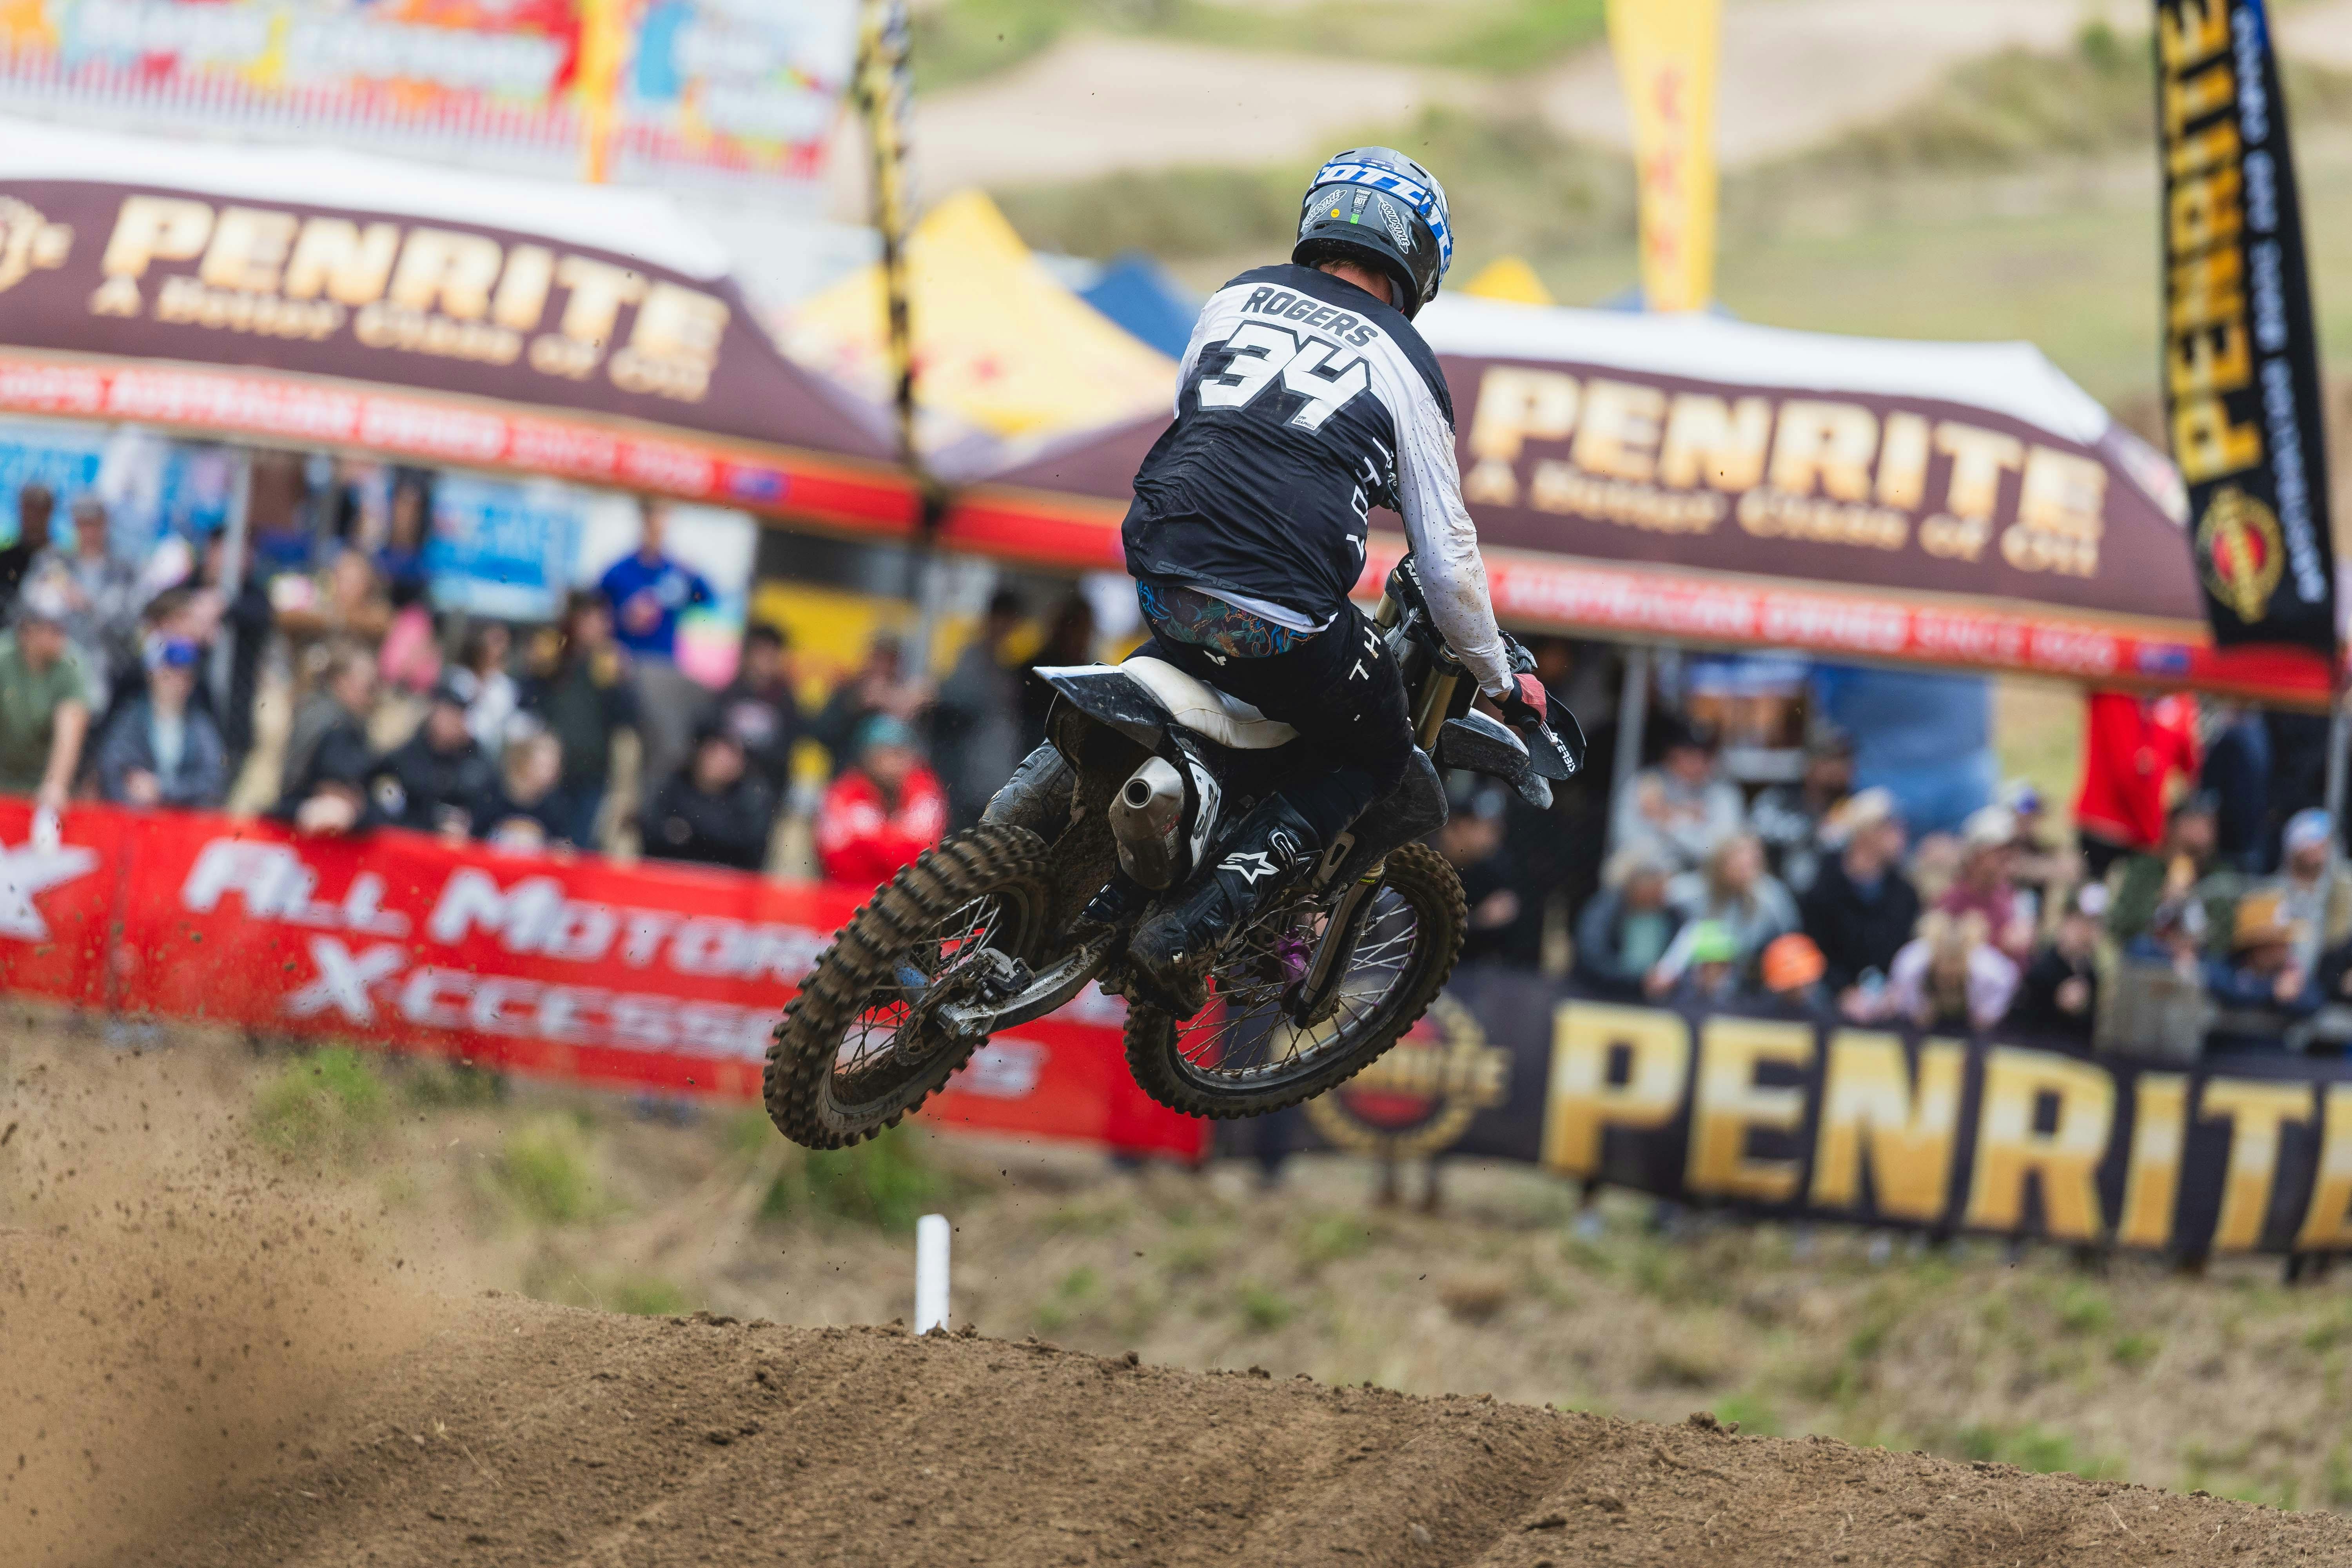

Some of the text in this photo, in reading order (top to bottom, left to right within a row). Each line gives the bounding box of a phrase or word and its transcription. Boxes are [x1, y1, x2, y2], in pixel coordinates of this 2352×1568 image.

[1354, 196, 1367, 205] DOT
[89, 272, 143, 317] A
[100, 194, 731, 363] PENRITE
[1240, 287, 1378, 347] ROGERS
[1196, 320, 1371, 435] 34
[1294, 419, 1316, 429] GRAPHICS
[1468, 364, 2108, 540] PENRITE
[1461, 457, 1517, 508] A
[182, 836, 412, 938] ALL
